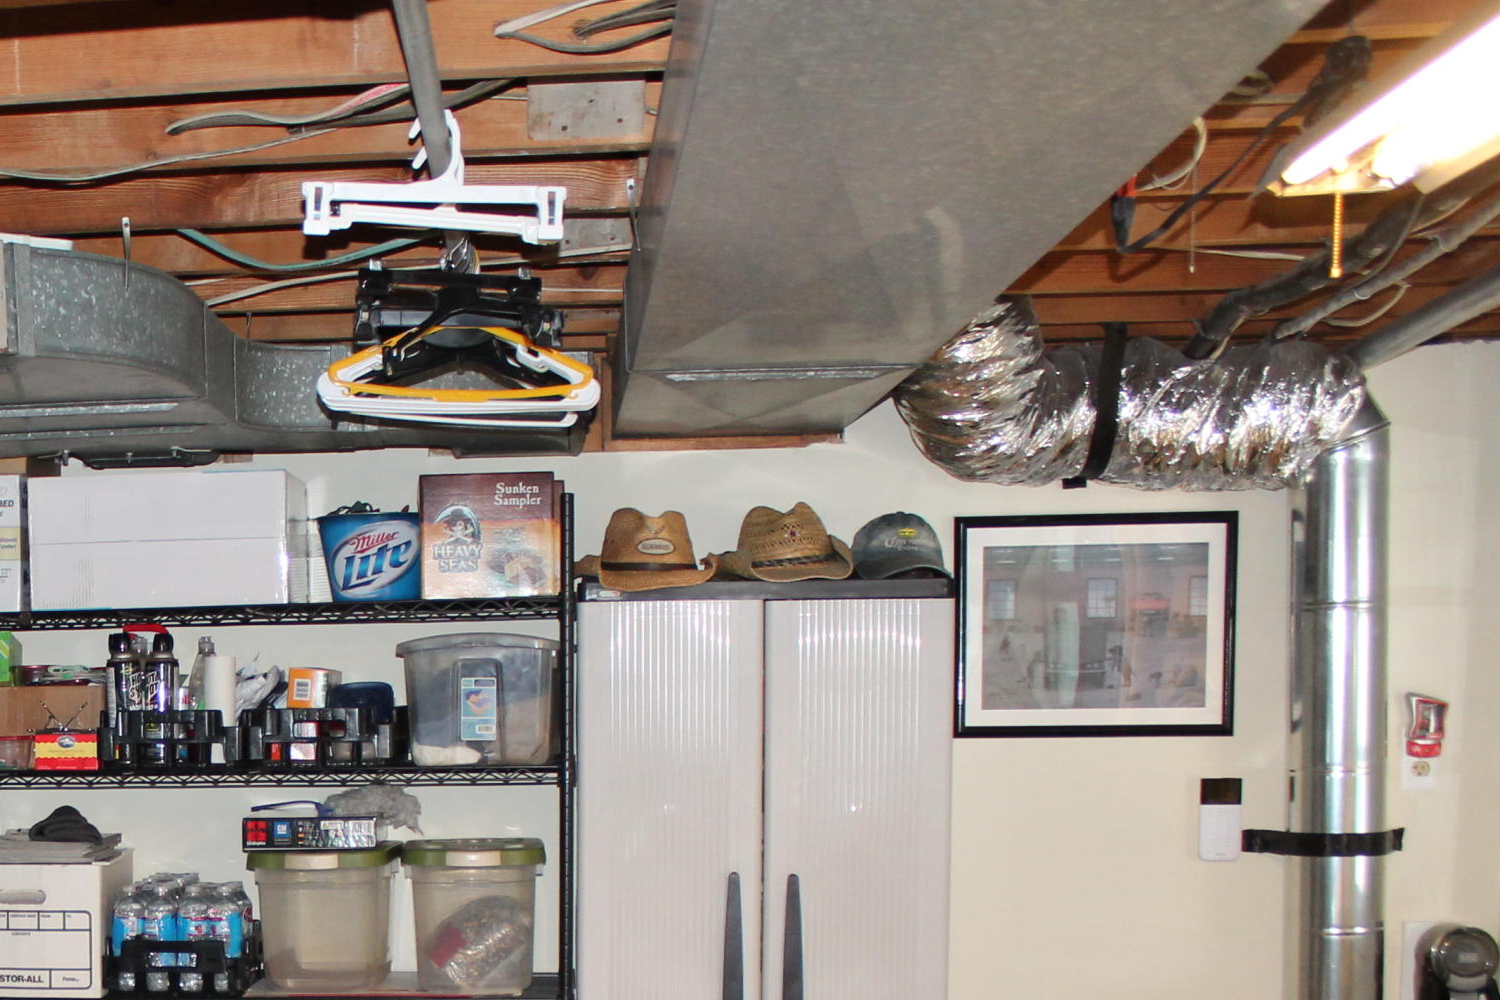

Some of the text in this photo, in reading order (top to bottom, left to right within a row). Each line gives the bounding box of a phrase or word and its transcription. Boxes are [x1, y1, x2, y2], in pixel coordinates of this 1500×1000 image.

[495, 480, 540, 494] Sunken
[494, 494, 542, 509] Sampler
[349, 531, 400, 552] Miller
[433, 544, 482, 558] HEAVY
[340, 540, 412, 592] Lite
[439, 559, 479, 570] SEAS
[0, 974, 44, 984] STOR-ALL
